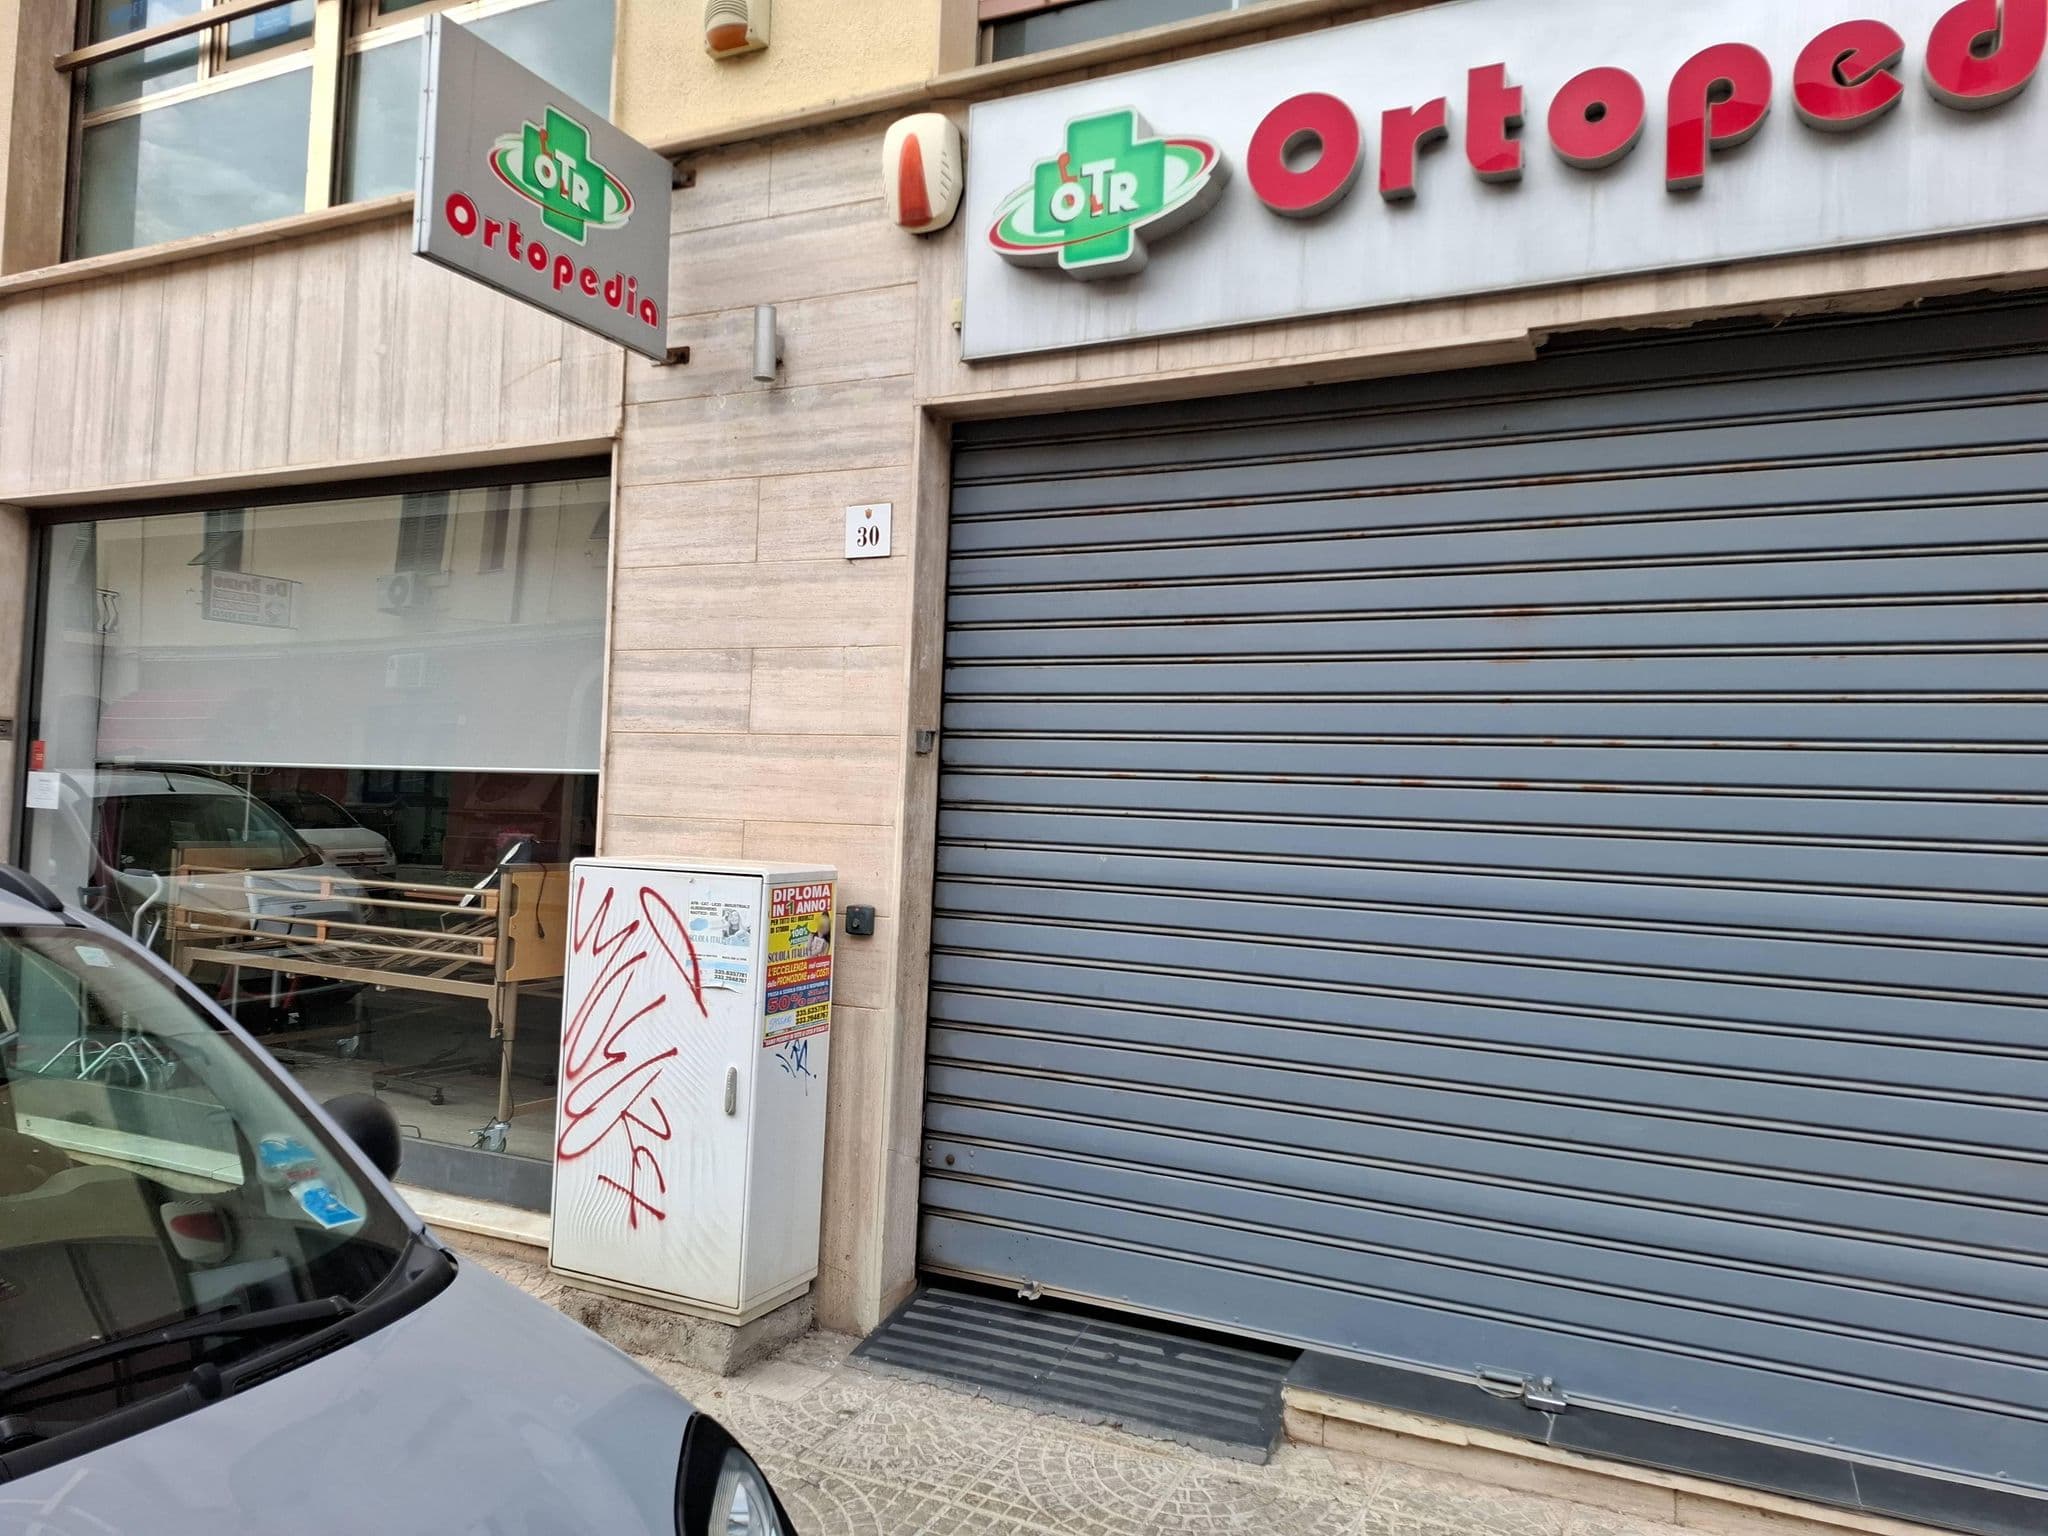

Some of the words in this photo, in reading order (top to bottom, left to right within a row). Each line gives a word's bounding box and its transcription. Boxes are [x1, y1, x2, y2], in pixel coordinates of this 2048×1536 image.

[533, 149, 590, 212] OTR
[1050, 158, 1139, 222] OTR
[444, 191, 661, 330] Ortopedia
[857, 525, 880, 548] 30
[773, 885, 830, 902] DIPLOMA
[773, 904, 784, 917] IN
[786, 900, 794, 915] 1
[796, 898, 830, 914] ANNO!
[768, 992, 806, 1013] 50%
